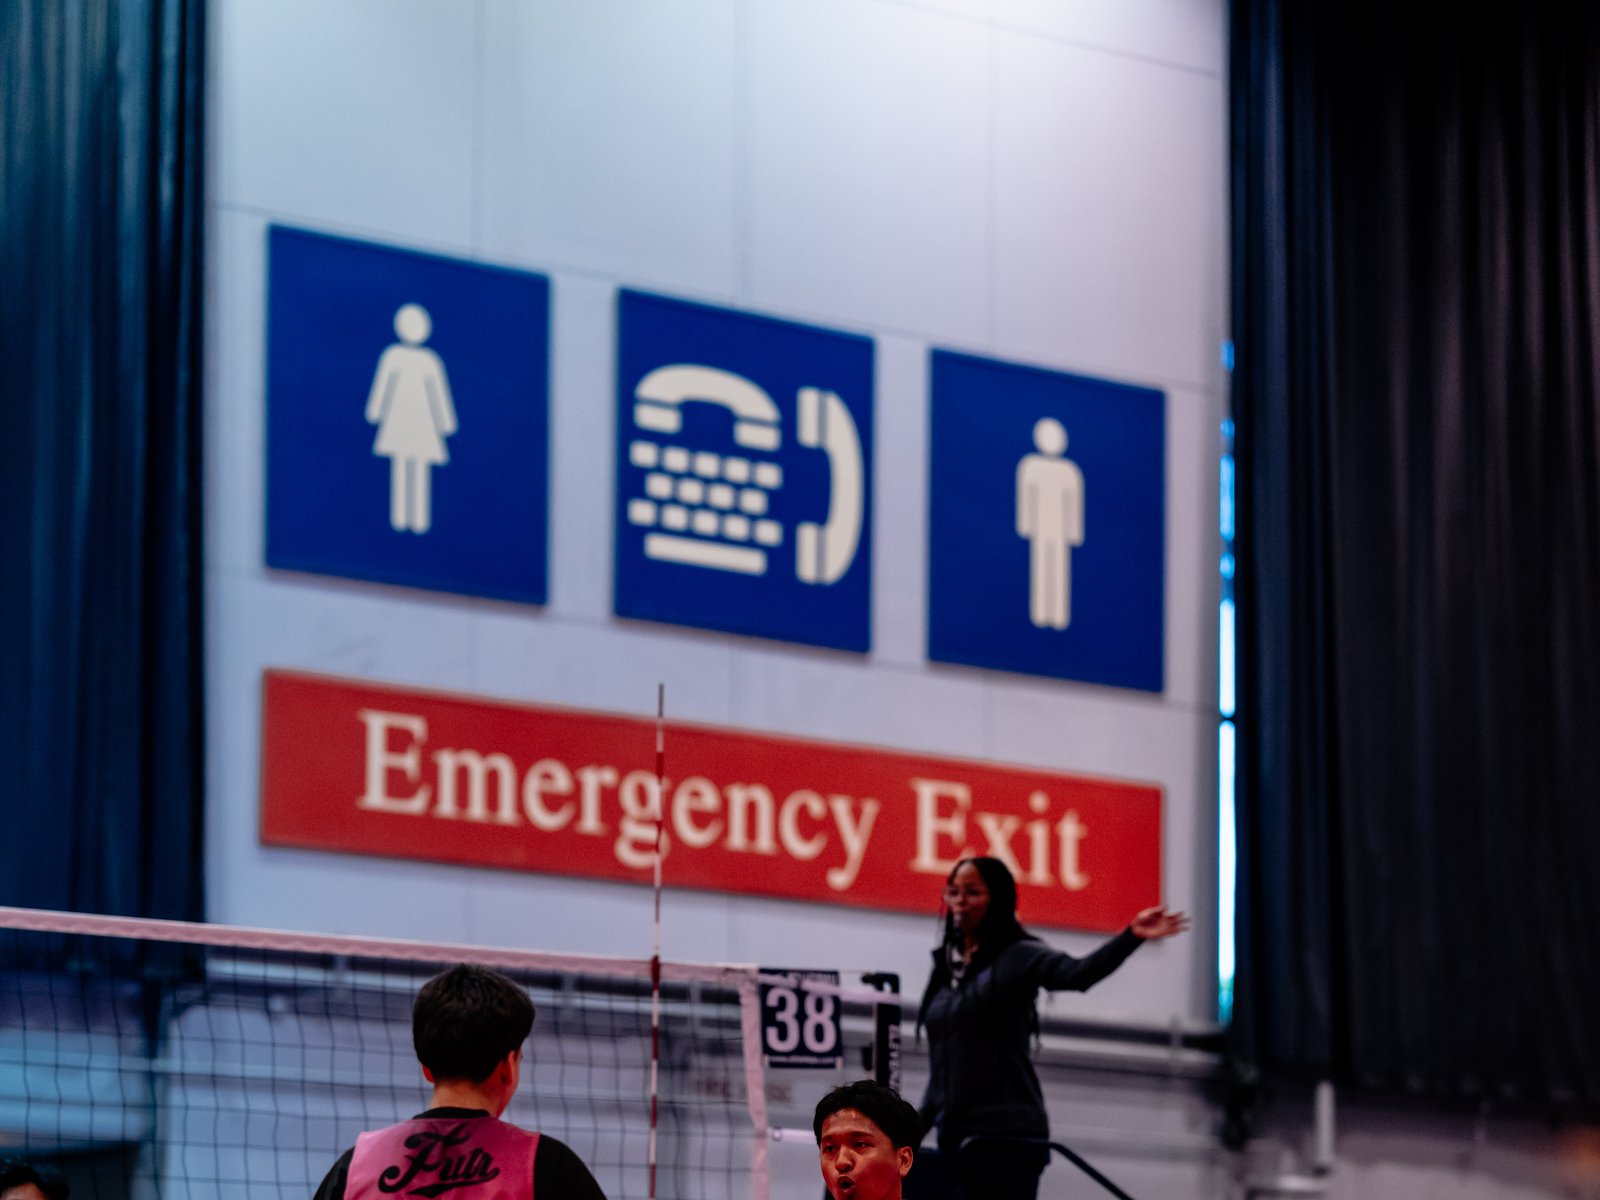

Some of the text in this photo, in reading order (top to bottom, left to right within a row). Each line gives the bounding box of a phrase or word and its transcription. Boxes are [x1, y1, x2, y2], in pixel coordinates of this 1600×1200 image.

[356, 708, 1089, 892] Emergency Exit
[765, 986, 838, 1054] 38
